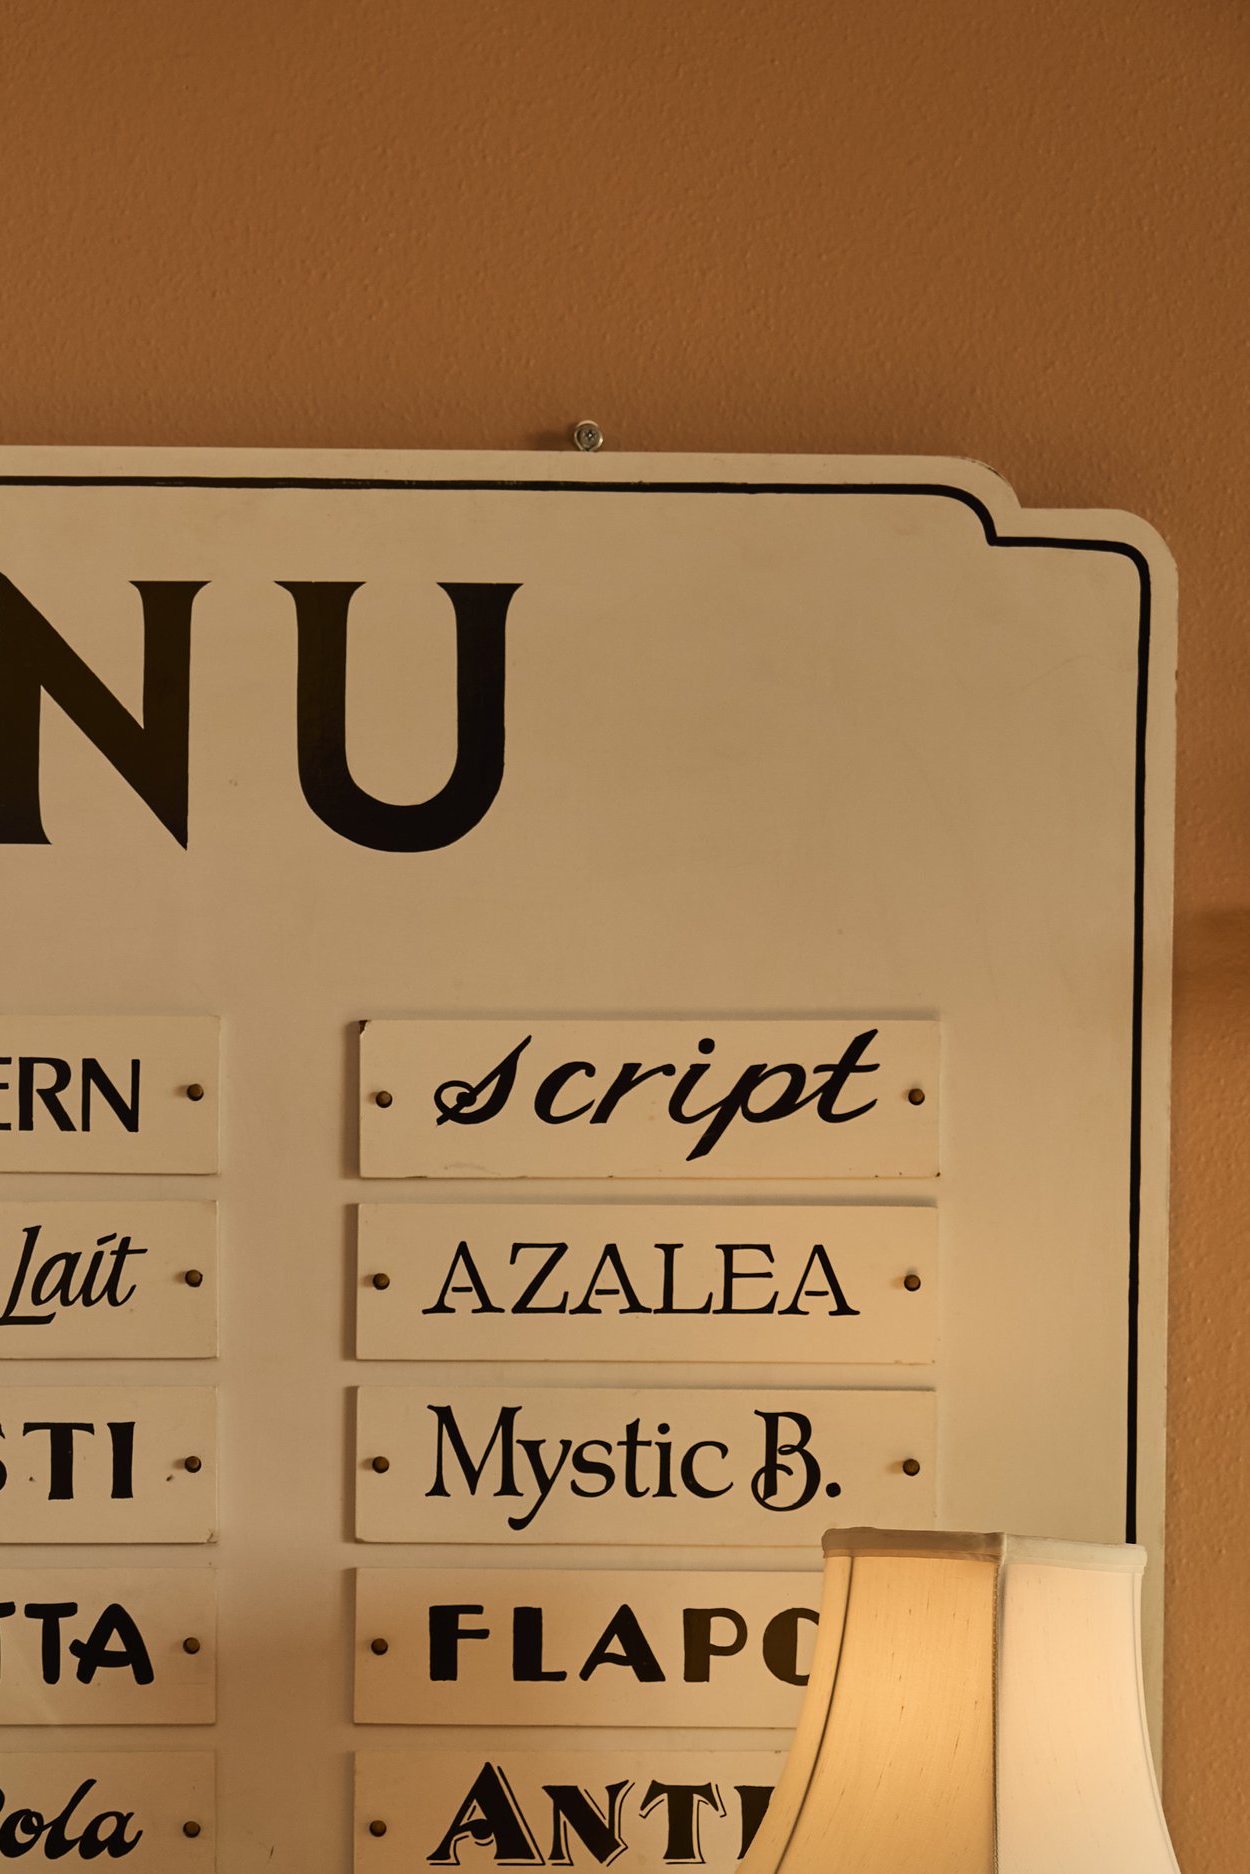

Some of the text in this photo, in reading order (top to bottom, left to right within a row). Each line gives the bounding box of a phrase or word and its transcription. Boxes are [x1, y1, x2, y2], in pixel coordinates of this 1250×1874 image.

[434, 1028, 881, 1162] script
[422, 1241, 860, 1317] AZALEA
[425, 1404, 842, 1531] Mystic B.
